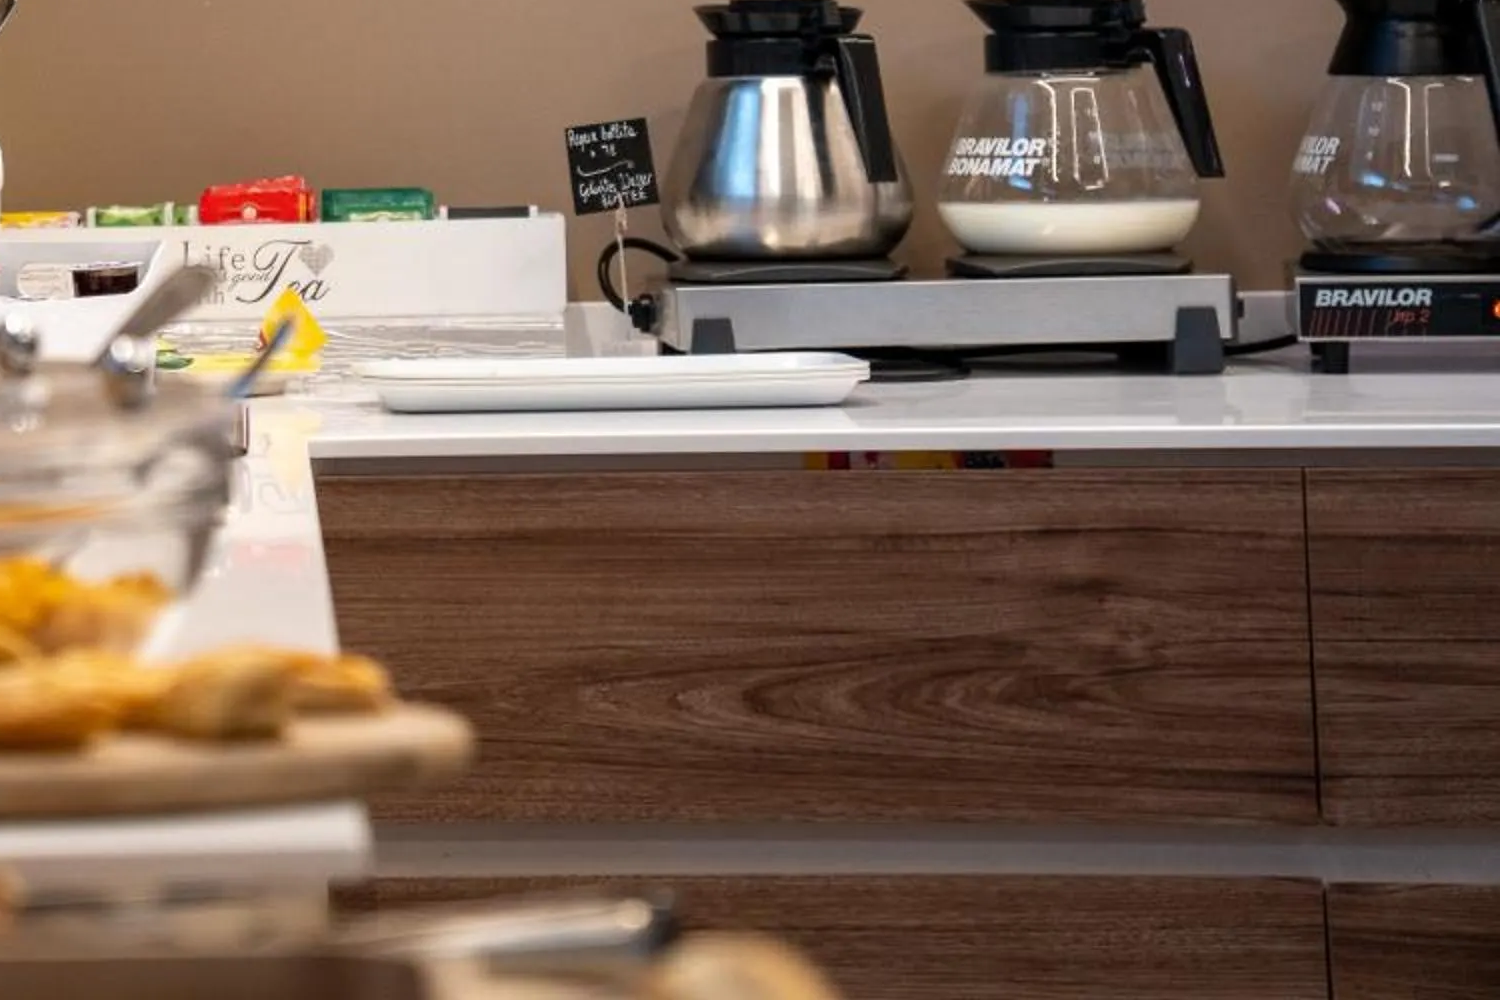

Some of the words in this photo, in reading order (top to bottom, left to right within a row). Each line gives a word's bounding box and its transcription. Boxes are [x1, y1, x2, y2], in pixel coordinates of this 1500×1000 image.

[956, 137, 1047, 157] BRAVILOR
[947, 157, 1042, 177] BONAMAT
[183, 240, 245, 271] Life
[235, 239, 331, 304] Tea
[1315, 288, 1433, 307] BRAVILOR
